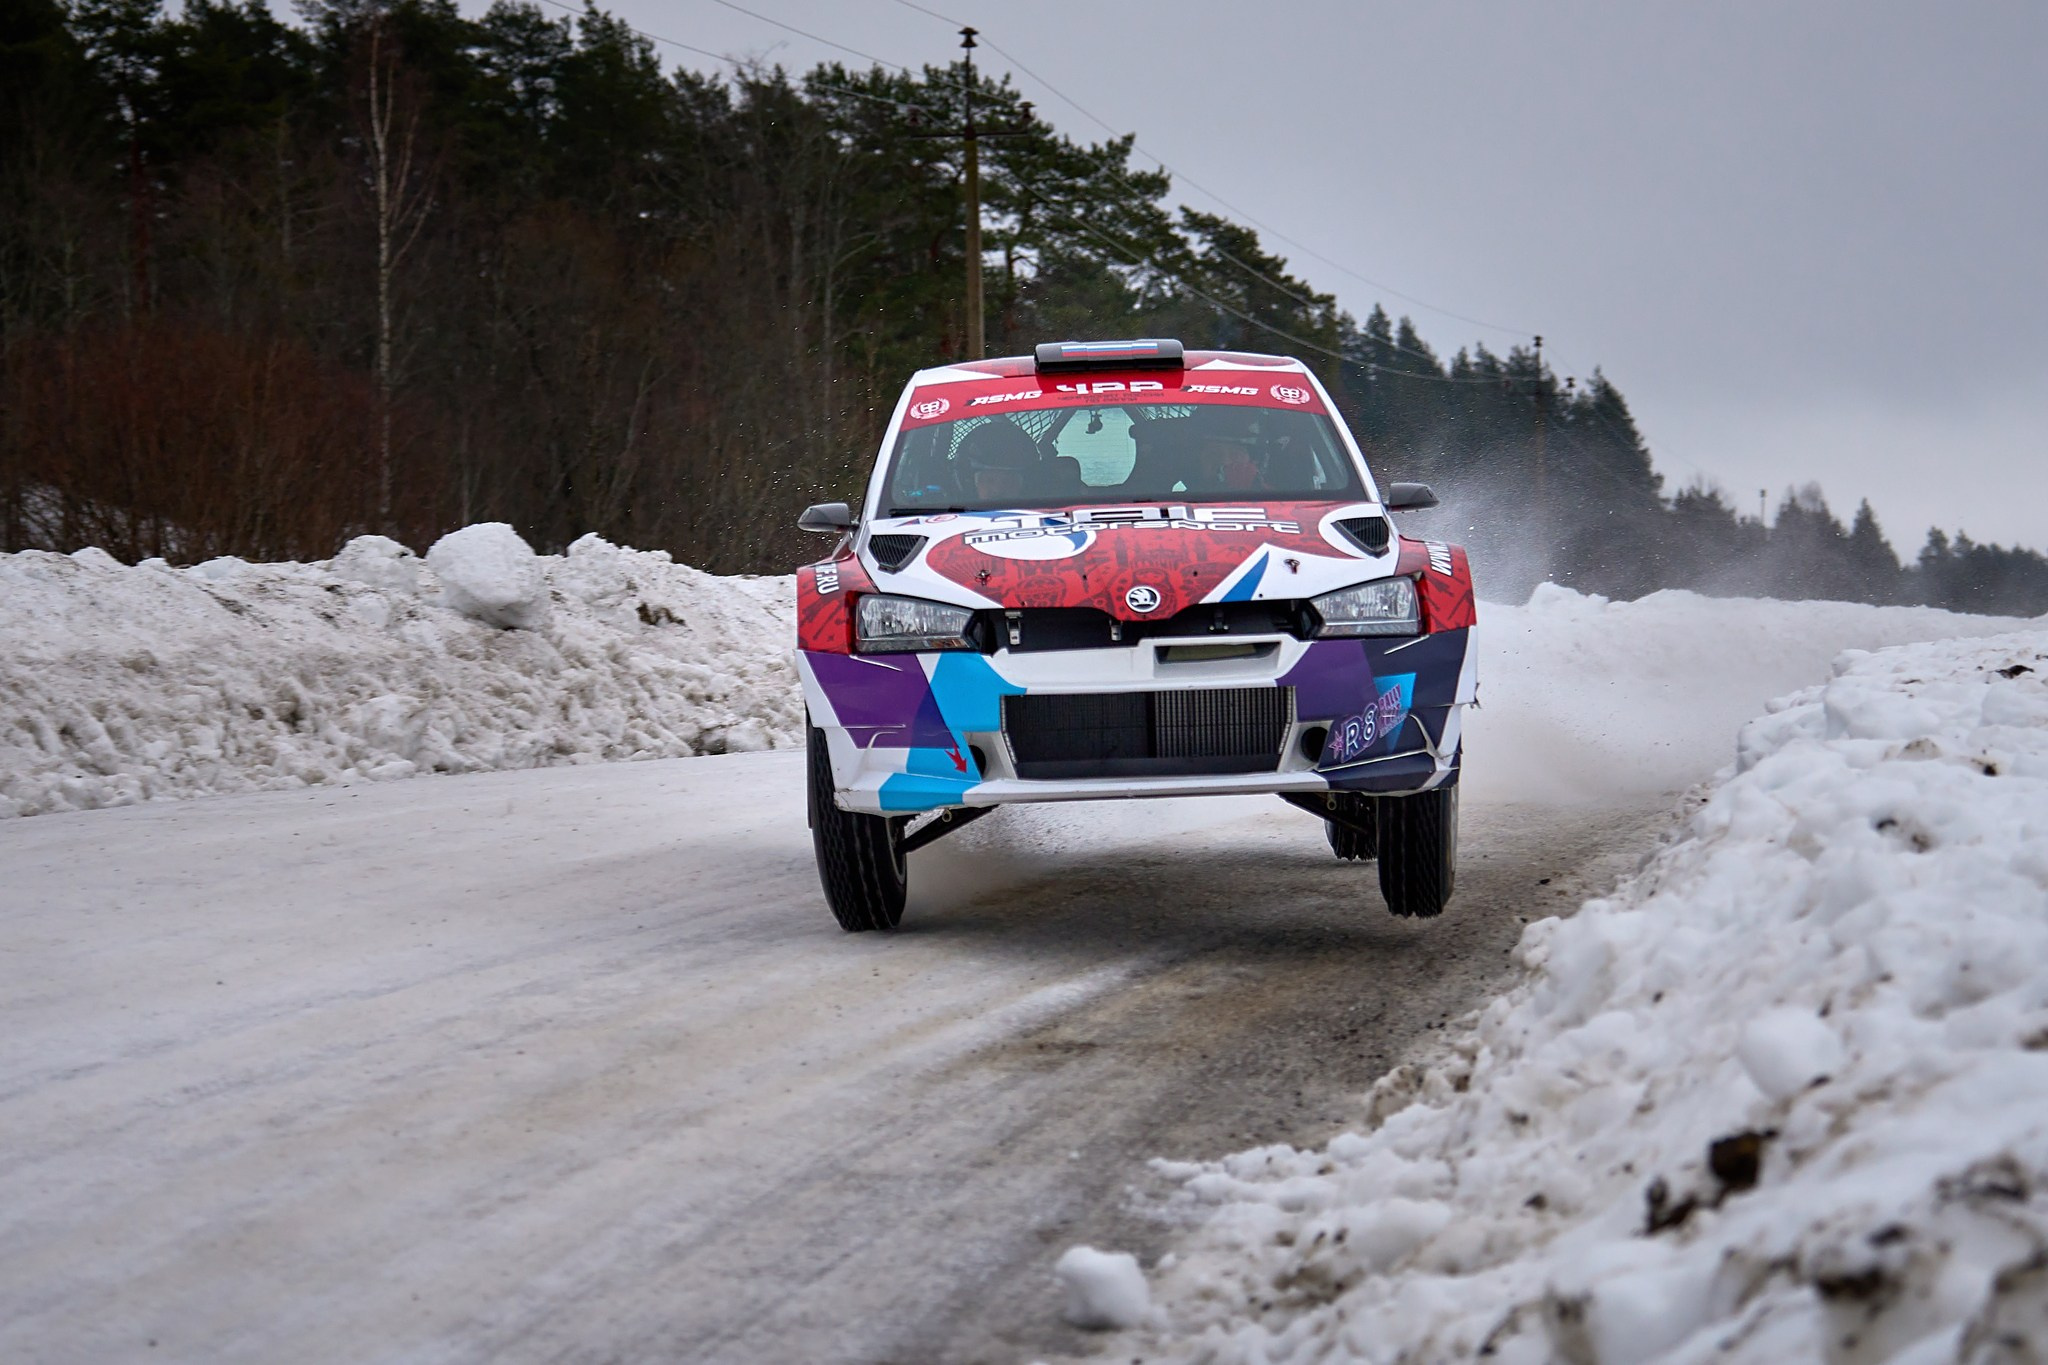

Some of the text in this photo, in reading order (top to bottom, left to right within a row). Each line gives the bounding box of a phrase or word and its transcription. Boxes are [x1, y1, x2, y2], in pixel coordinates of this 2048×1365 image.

[1187, 384, 1259, 395] ASMG
[970, 390, 1043, 407] ASMG
[965, 520, 1301, 545] motorsport
